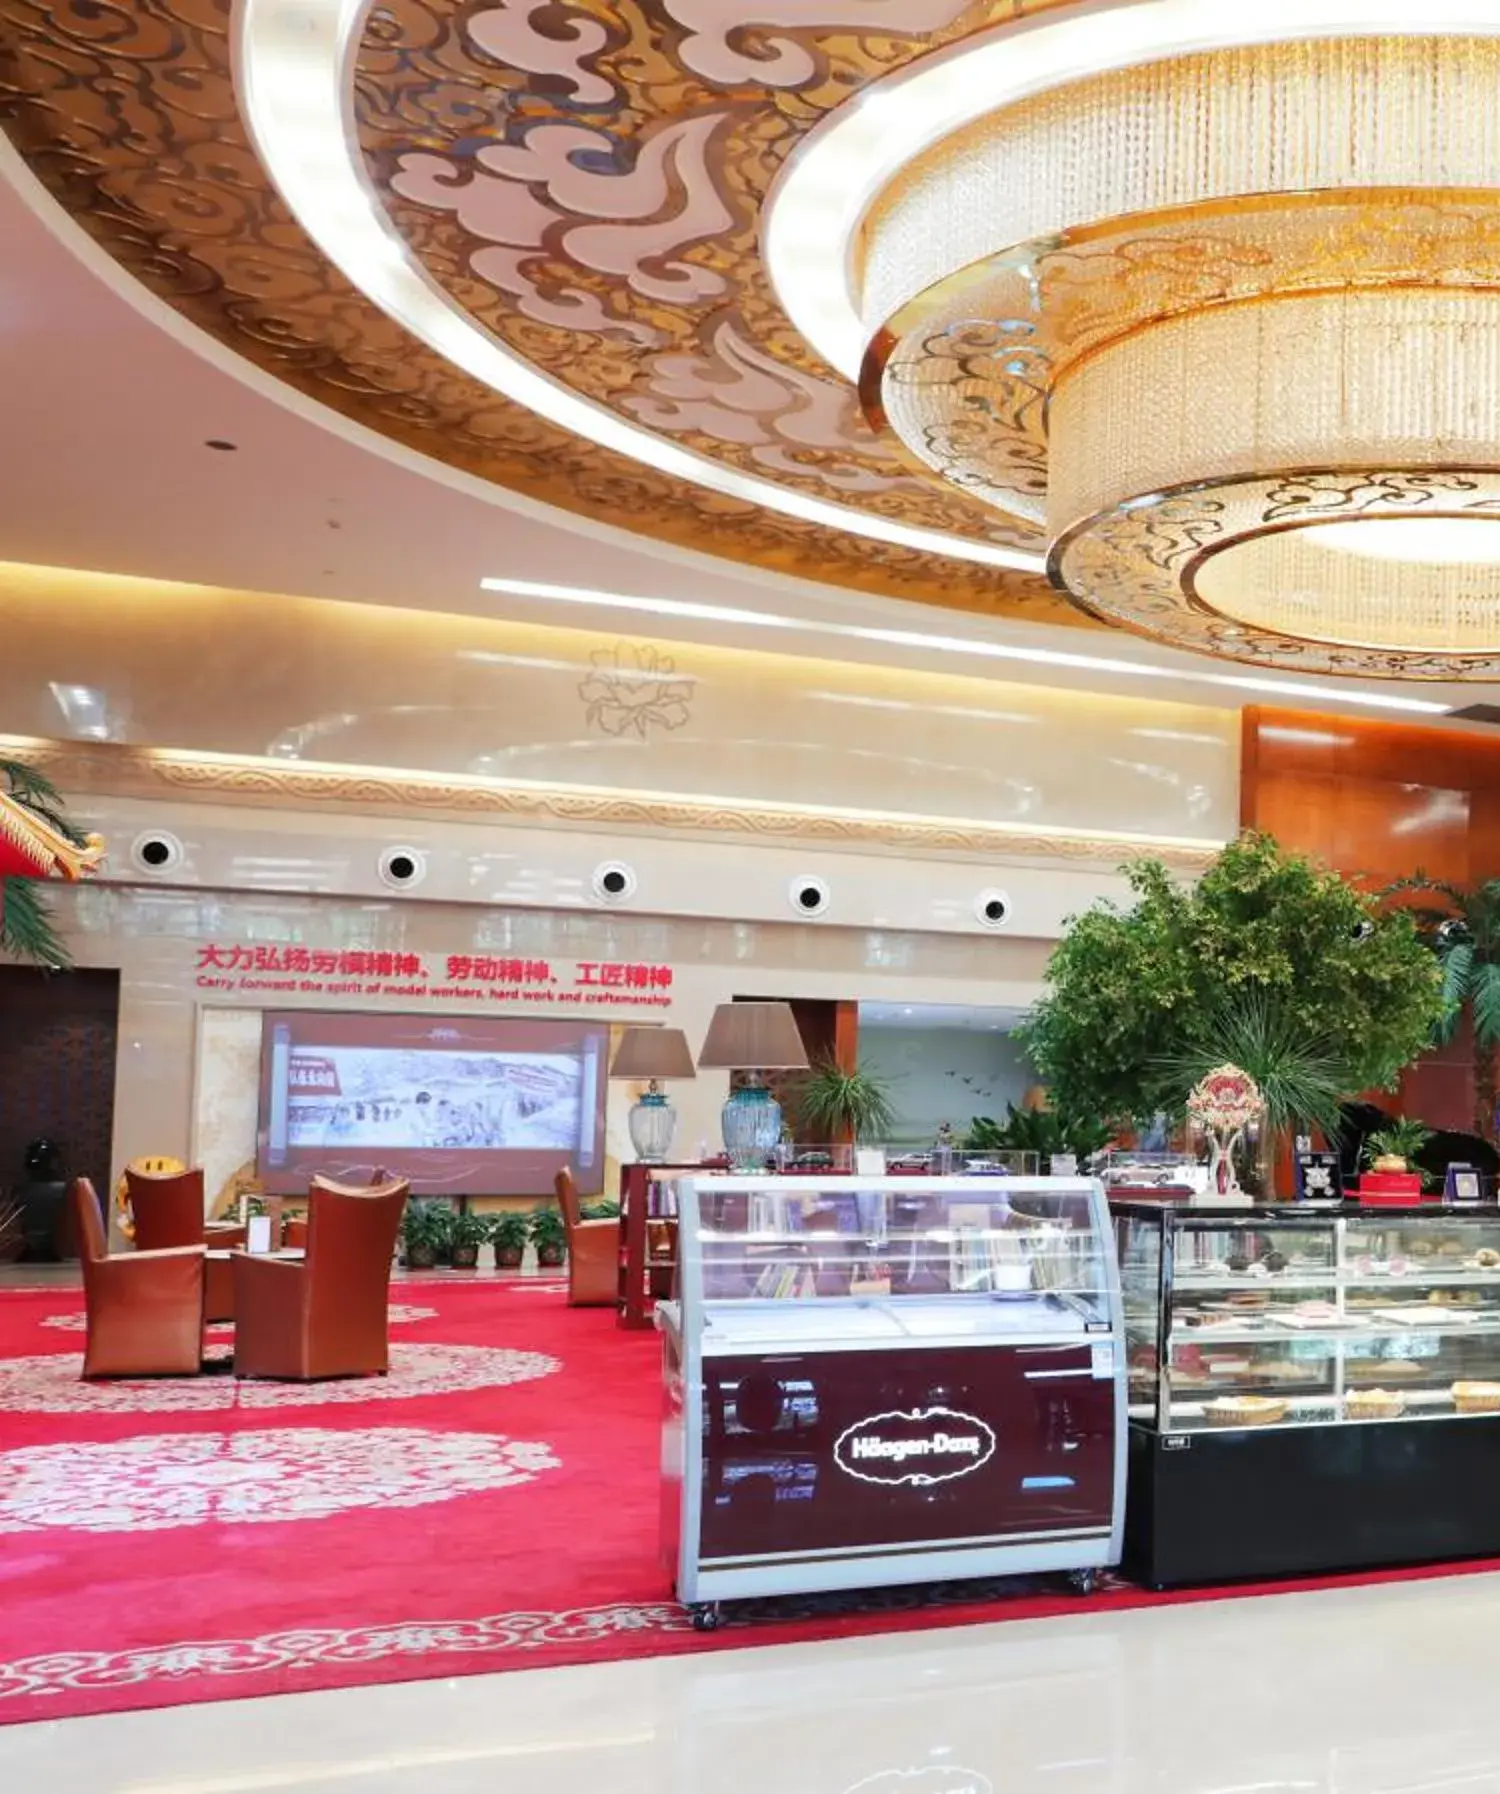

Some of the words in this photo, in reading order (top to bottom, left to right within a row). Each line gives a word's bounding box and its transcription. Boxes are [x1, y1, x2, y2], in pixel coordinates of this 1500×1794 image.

[196, 974, 234, 990] Carry
[240, 976, 297, 991] forward
[301, 978, 324, 992] the
[327, 981, 363, 995] spirit
[366, 981, 382, 994] of
[384, 982, 428, 996] model
[430, 986, 484, 1000] workers,
[489, 987, 520, 1000] hard
[522, 989, 553, 1001] work
[557, 990, 583, 1003] and
[585, 991, 673, 1008] craftsmanship
